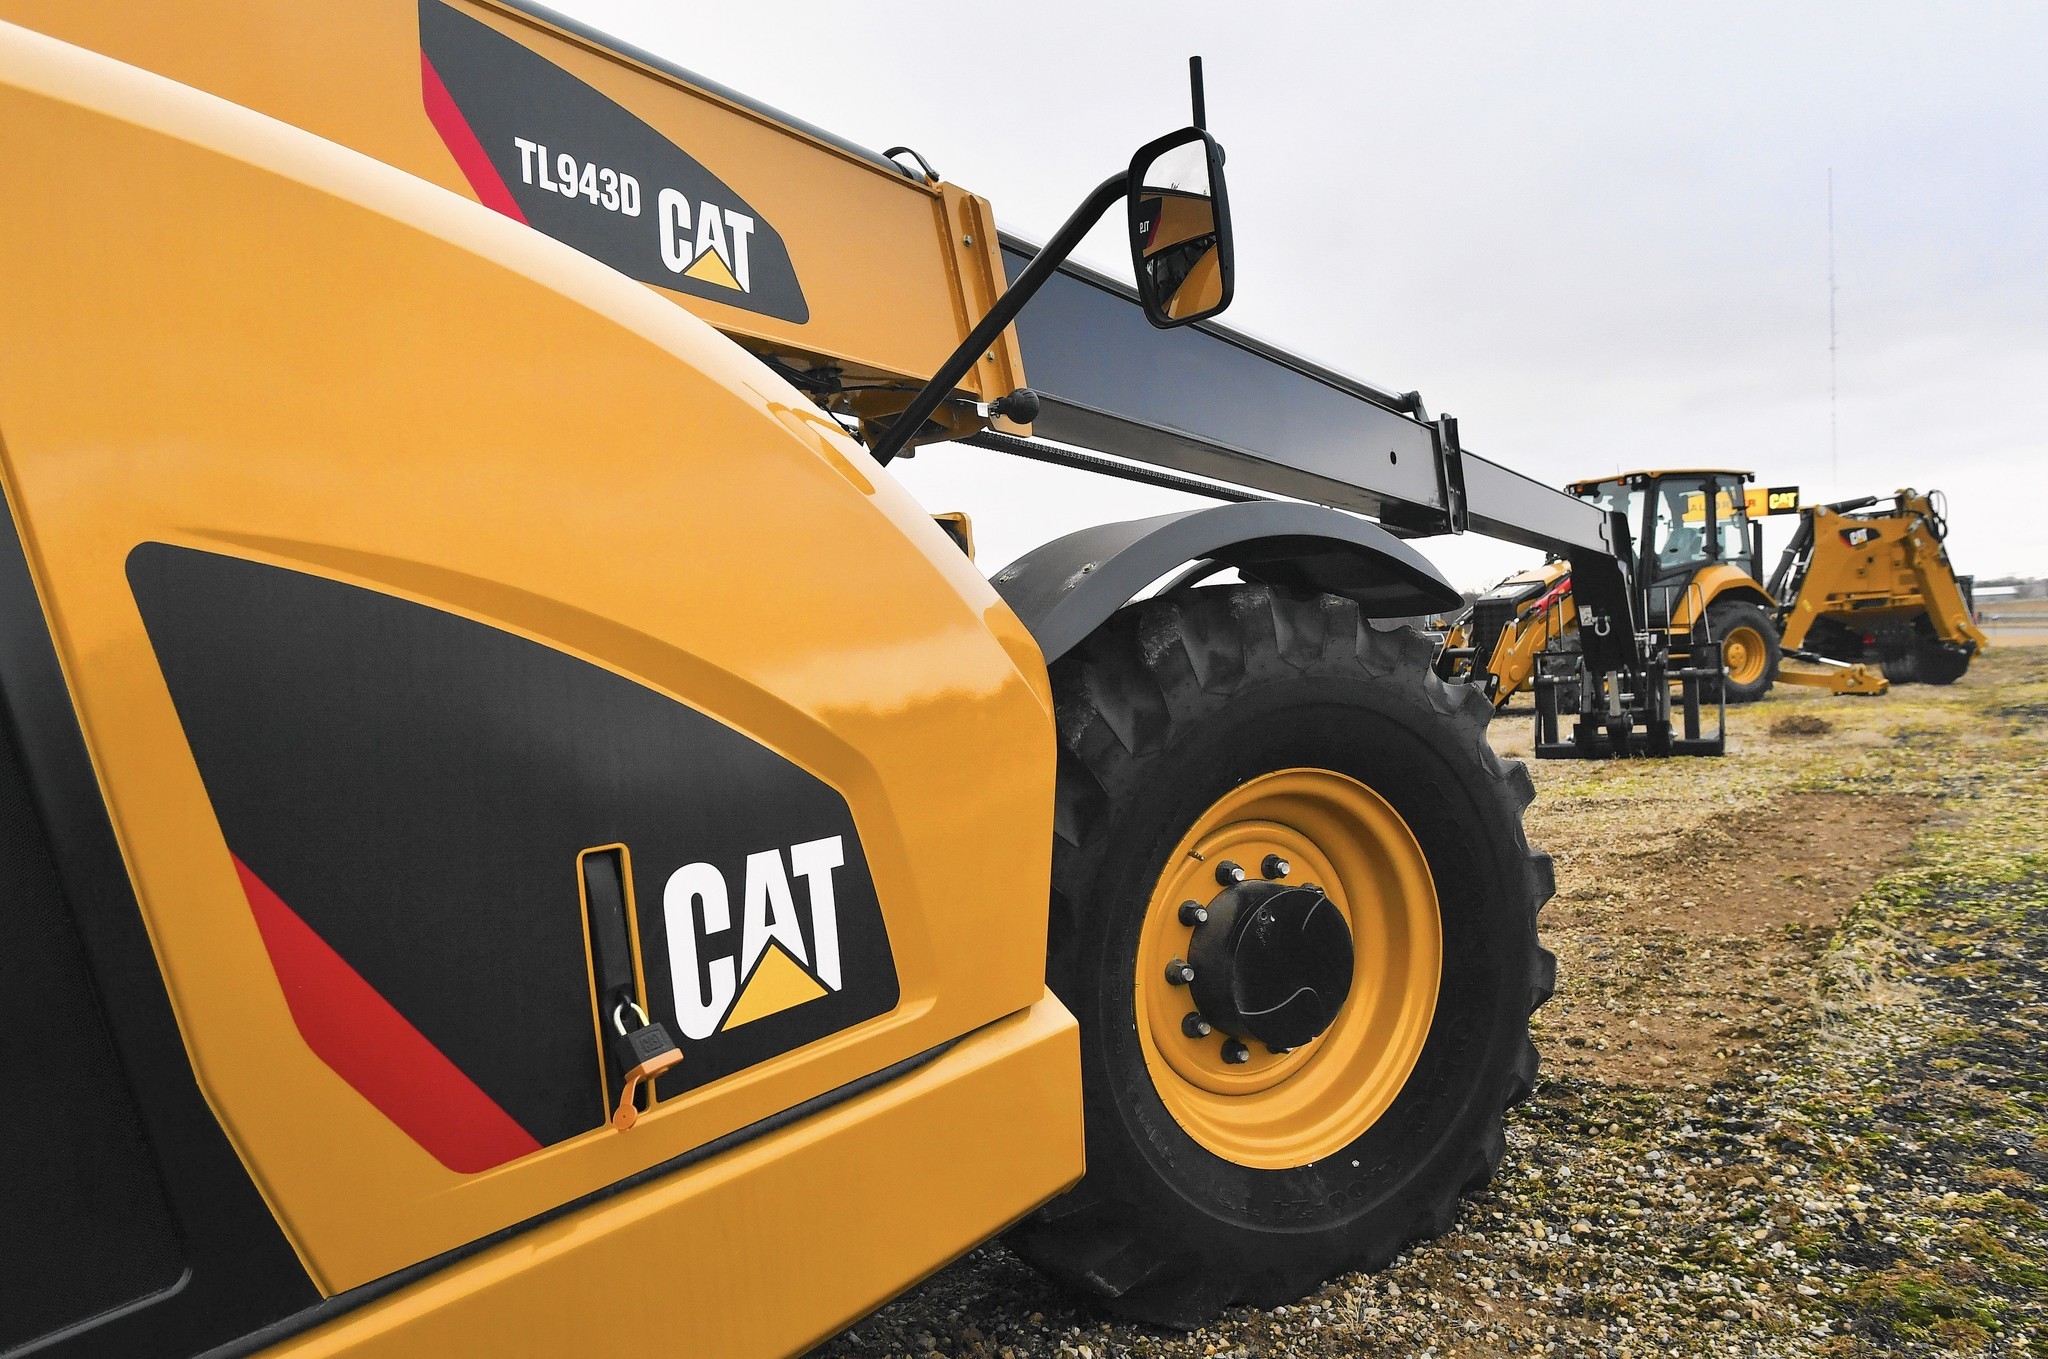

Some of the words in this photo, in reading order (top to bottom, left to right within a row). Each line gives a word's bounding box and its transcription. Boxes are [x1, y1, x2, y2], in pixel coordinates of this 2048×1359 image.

[514, 136, 641, 217] TL943D
[659, 188, 754, 294] CAT
[1769, 492, 1797, 509] CAT
[1849, 528, 1868, 546] CAT
[664, 835, 845, 1040] CAT
